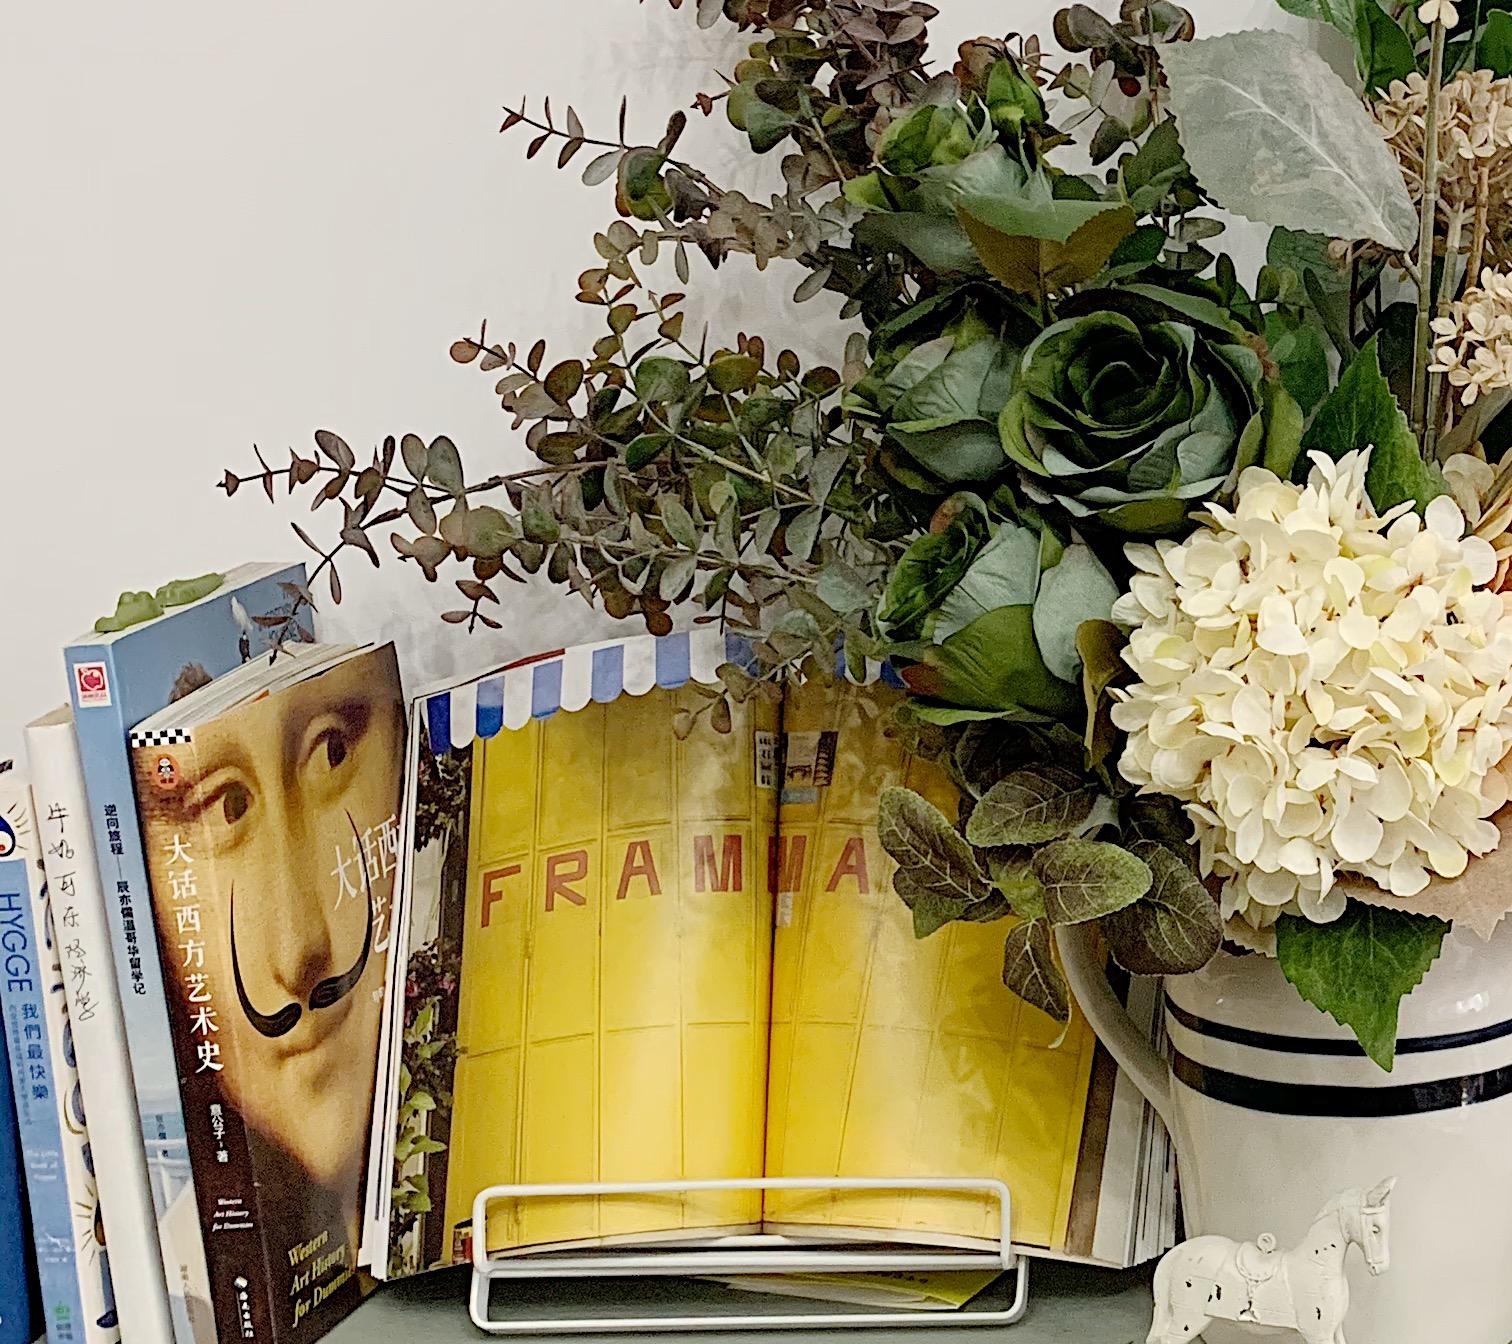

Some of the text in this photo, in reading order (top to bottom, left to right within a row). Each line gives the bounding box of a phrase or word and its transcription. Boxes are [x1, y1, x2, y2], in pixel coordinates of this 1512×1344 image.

[330, 812, 399, 912] 大话西
[0, 892, 33, 993] HYGGE
[163, 833, 224, 1074] 大话西方艺术史
[371, 895, 393, 954] 艺
[21, 1002, 49, 1101] 我們最快樂
[287, 1230, 329, 1267] Western
[289, 1243, 346, 1297] Art History
[292, 1297, 312, 1329] for
